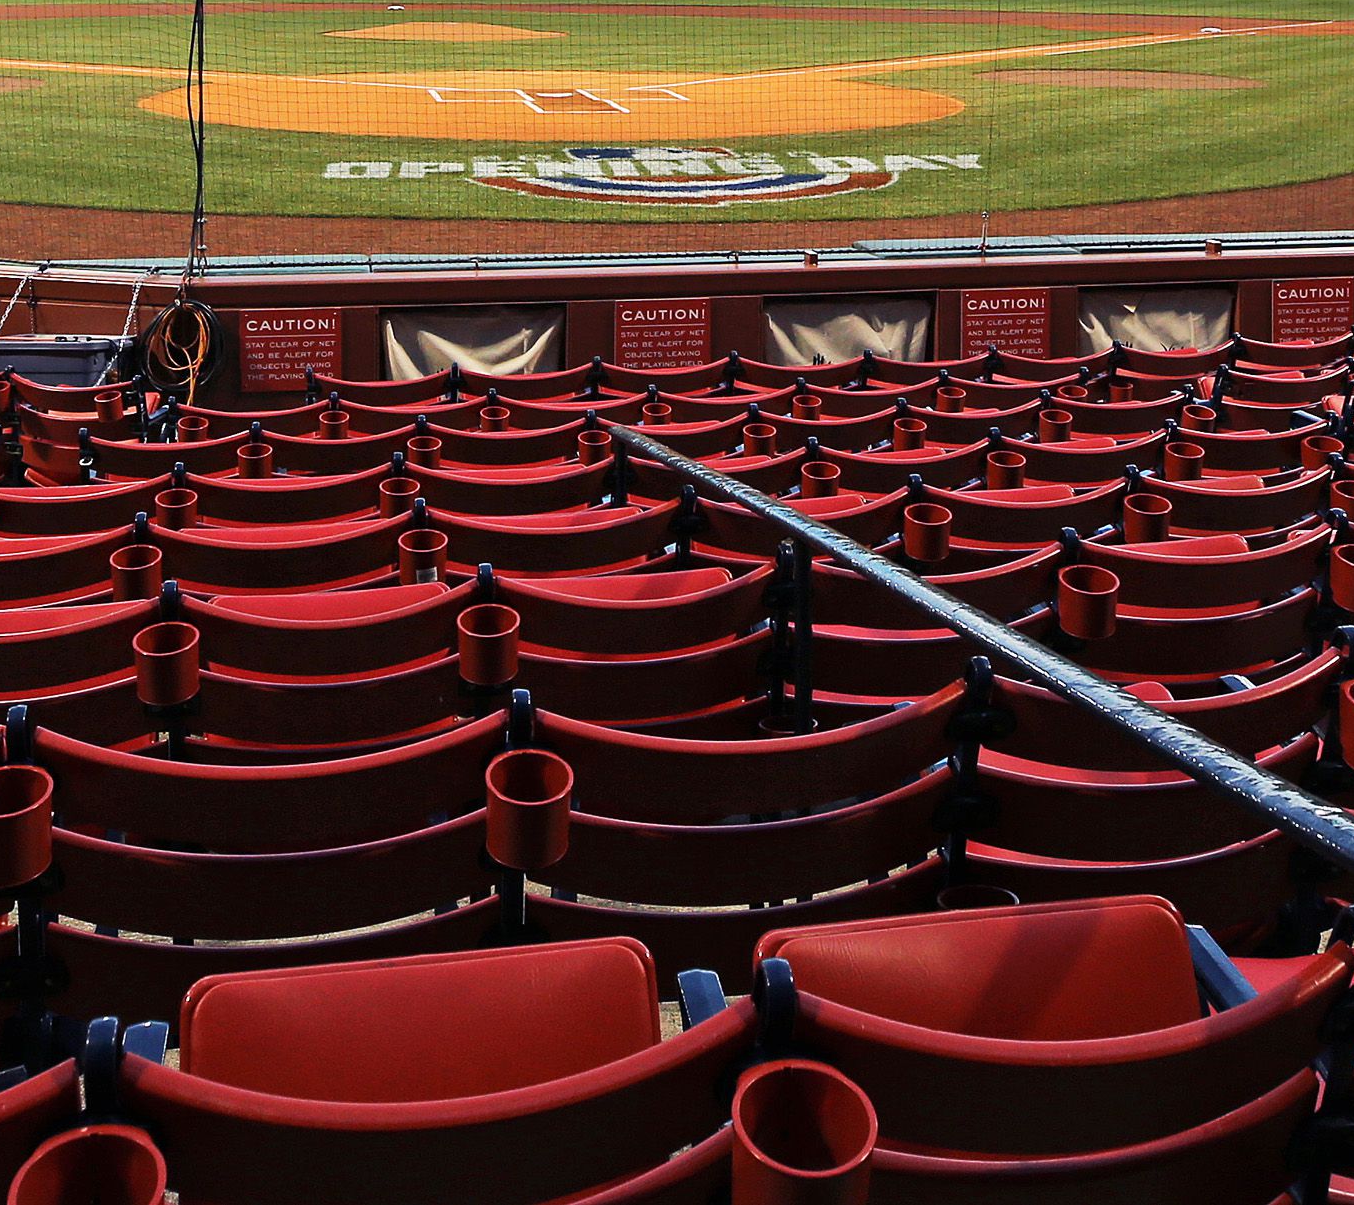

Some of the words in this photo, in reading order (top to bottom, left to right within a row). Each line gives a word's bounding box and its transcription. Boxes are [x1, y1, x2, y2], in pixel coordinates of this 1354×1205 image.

[323, 156, 784, 180] OPENING
[788, 151, 983, 174] DAY
[1278, 287, 1350, 300] CAUTION!
[967, 298, 1045, 311] CAUTION!
[621, 309, 705, 321] CAUTION!
[246, 318, 336, 332] CAUTION!
[643, 330, 671, 338] CLEAR
[624, 351, 663, 359] OBJECTS
[642, 361, 676, 369] PLAYING
